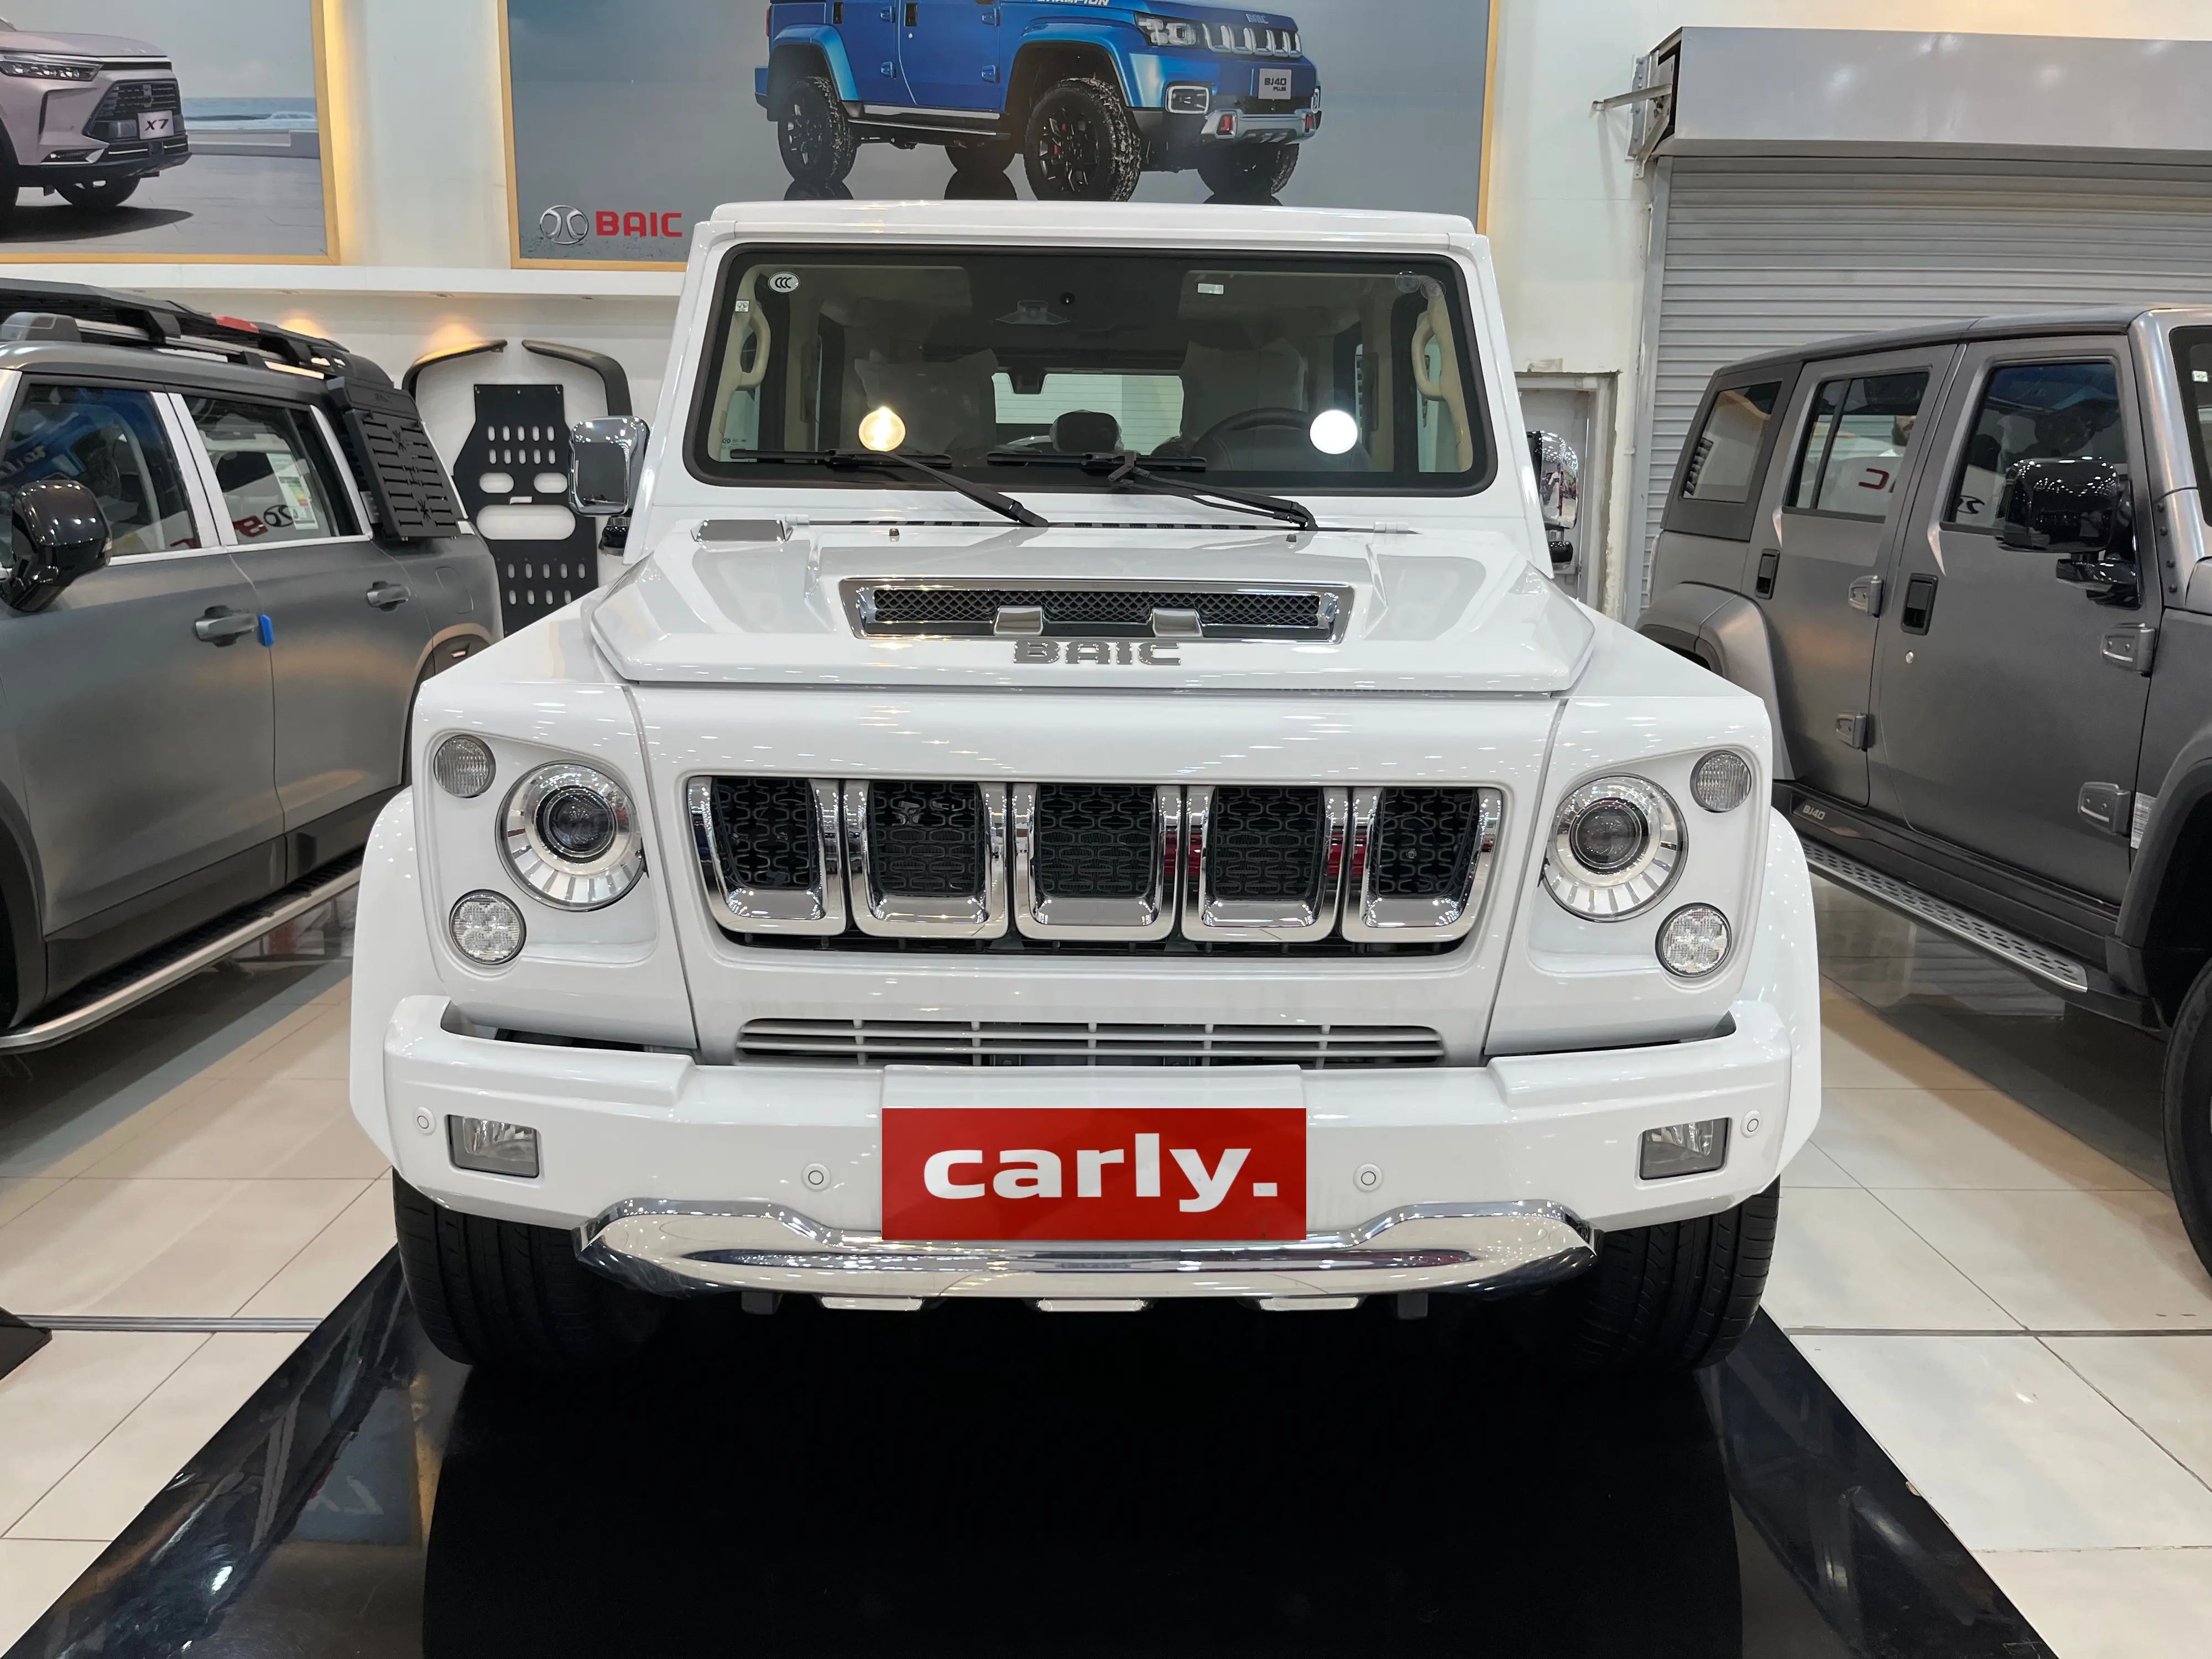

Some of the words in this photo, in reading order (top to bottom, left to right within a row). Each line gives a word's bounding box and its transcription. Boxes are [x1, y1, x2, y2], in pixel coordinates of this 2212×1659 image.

[1264, 77, 1286, 86] BJ40
[144, 119, 169, 132] X7
[596, 211, 683, 237] BAIC
[1014, 640, 1181, 665] BAIC
[1803, 805, 1825, 820] BJ40
[924, 1133, 1277, 1212] carly.
